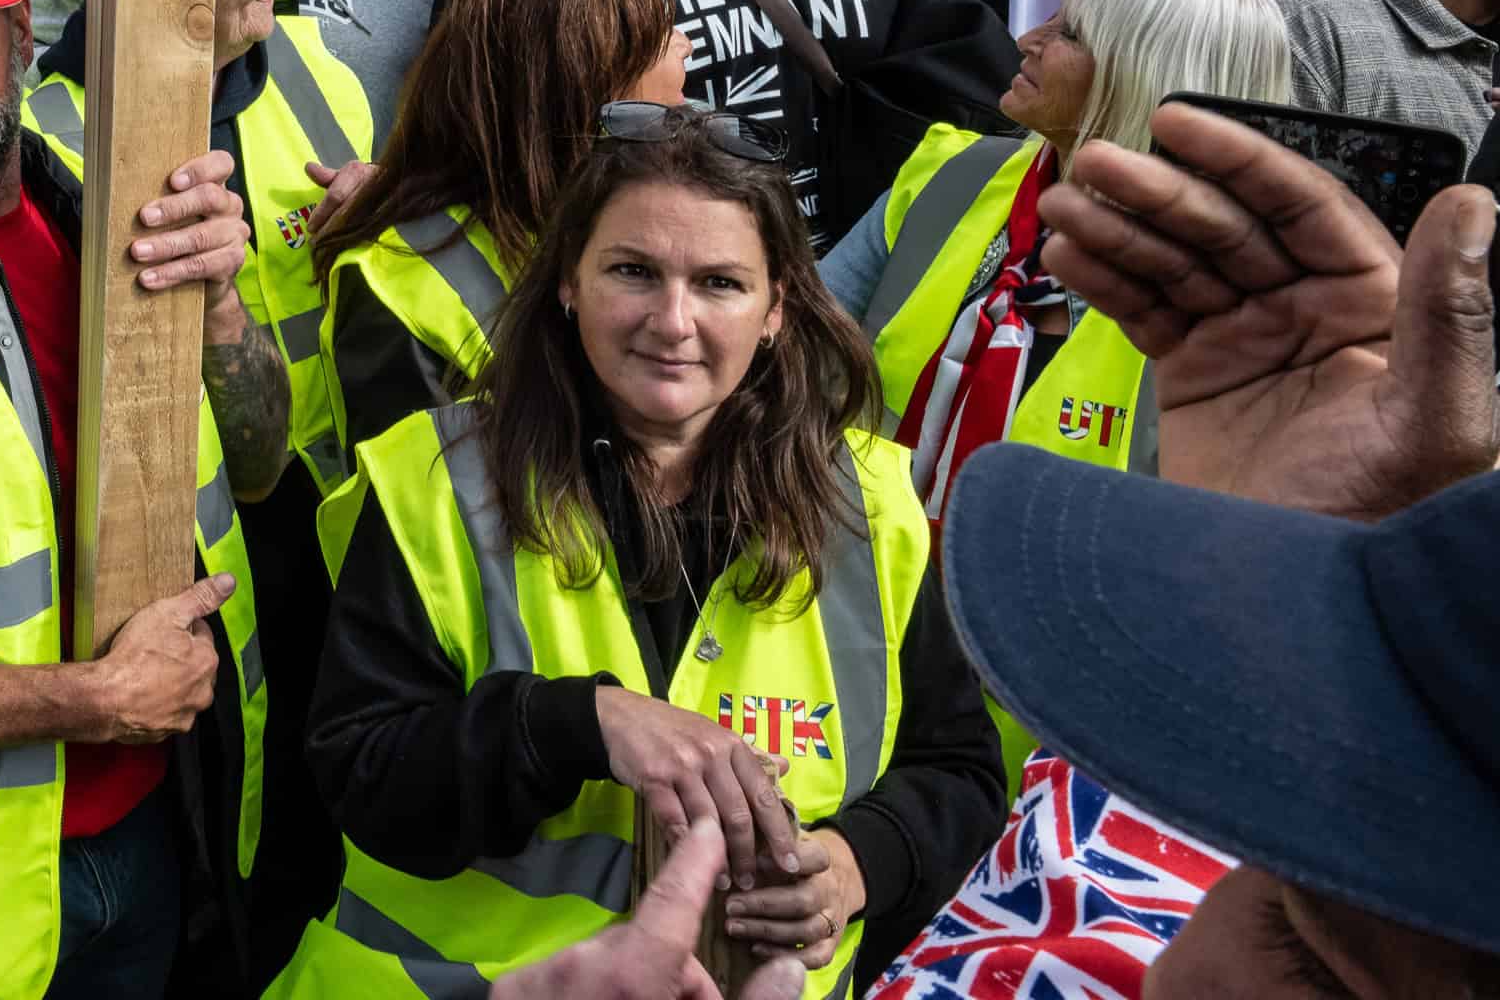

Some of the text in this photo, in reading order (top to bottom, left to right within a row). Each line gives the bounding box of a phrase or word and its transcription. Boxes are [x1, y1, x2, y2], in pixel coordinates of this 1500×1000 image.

[276, 203, 317, 249] UT
[1059, 397, 1128, 447] UT
[719, 693, 835, 760] UTK
